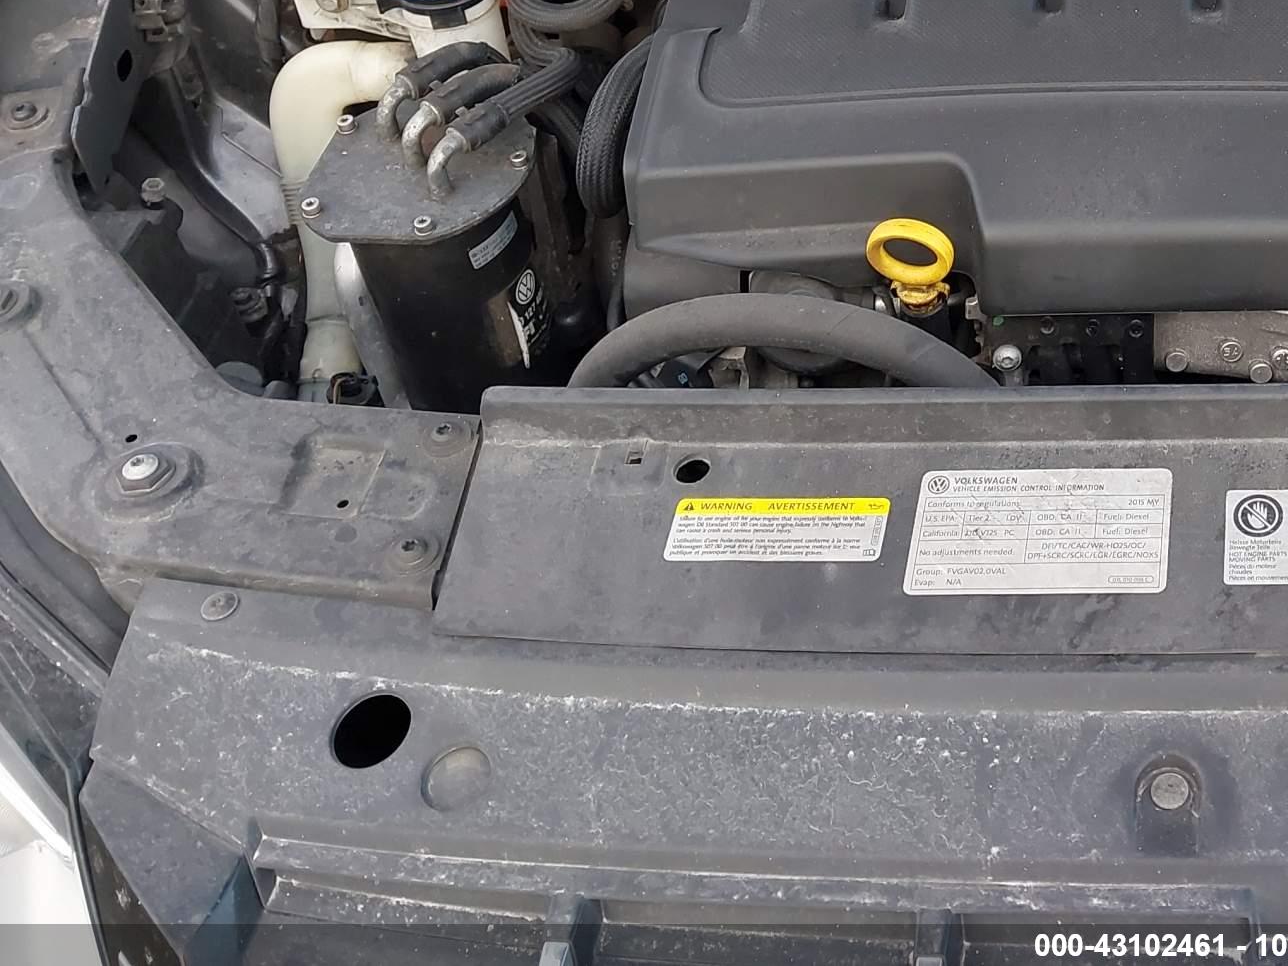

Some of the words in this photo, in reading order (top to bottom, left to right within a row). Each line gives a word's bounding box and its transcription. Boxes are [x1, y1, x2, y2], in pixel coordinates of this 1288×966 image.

[954, 476, 1018, 485] VOLKSWAGEN
[1020, 484, 1051, 492] CONTROL
[927, 500, 964, 508] Conforms
[1128, 498, 1145, 506] 2015
[1146, 498, 1160, 506] MY
[700, 502, 753, 510] WARNING
[768, 502, 856, 511] AVERTISSEMENT
[932, 548, 982, 558] adjustments
